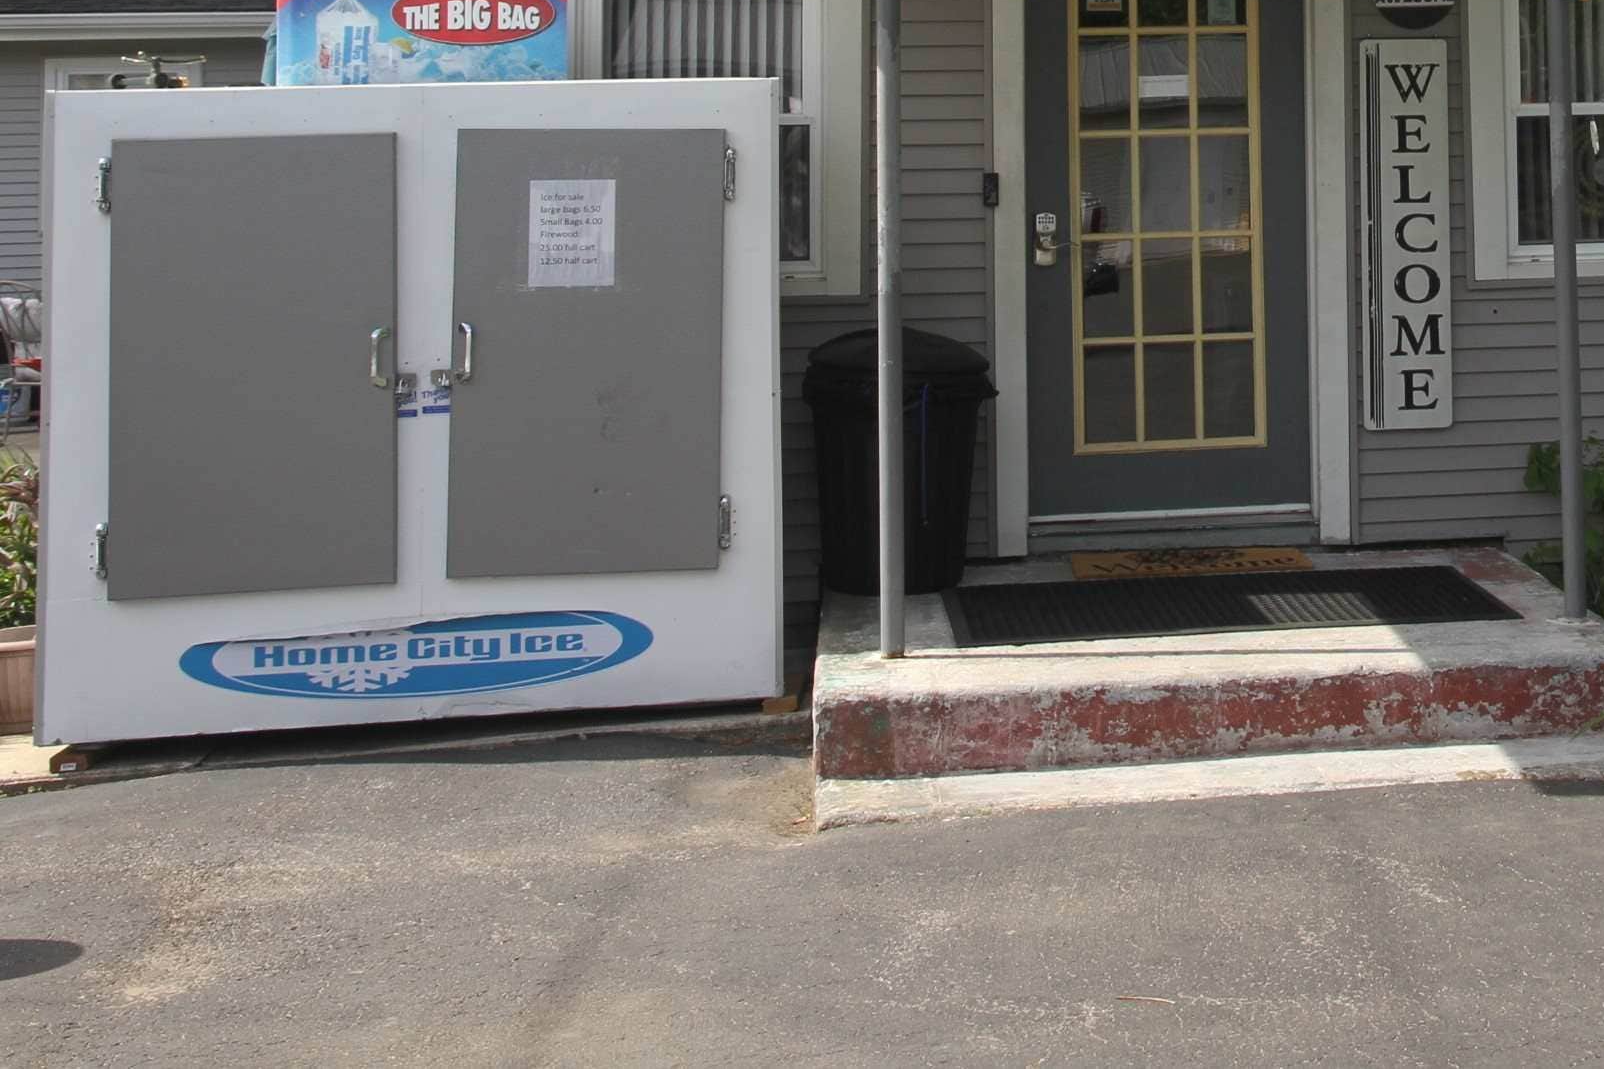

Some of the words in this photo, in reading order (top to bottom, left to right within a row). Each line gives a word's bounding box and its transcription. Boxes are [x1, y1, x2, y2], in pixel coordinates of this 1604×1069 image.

[403, 3, 440, 30] THE
[498, 1, 540, 30] BAG
[1383, 63, 1446, 411] WELCOME
[253, 643, 398, 669] Home
[407, 634, 500, 662] City
[510, 631, 585, 655] Ice
